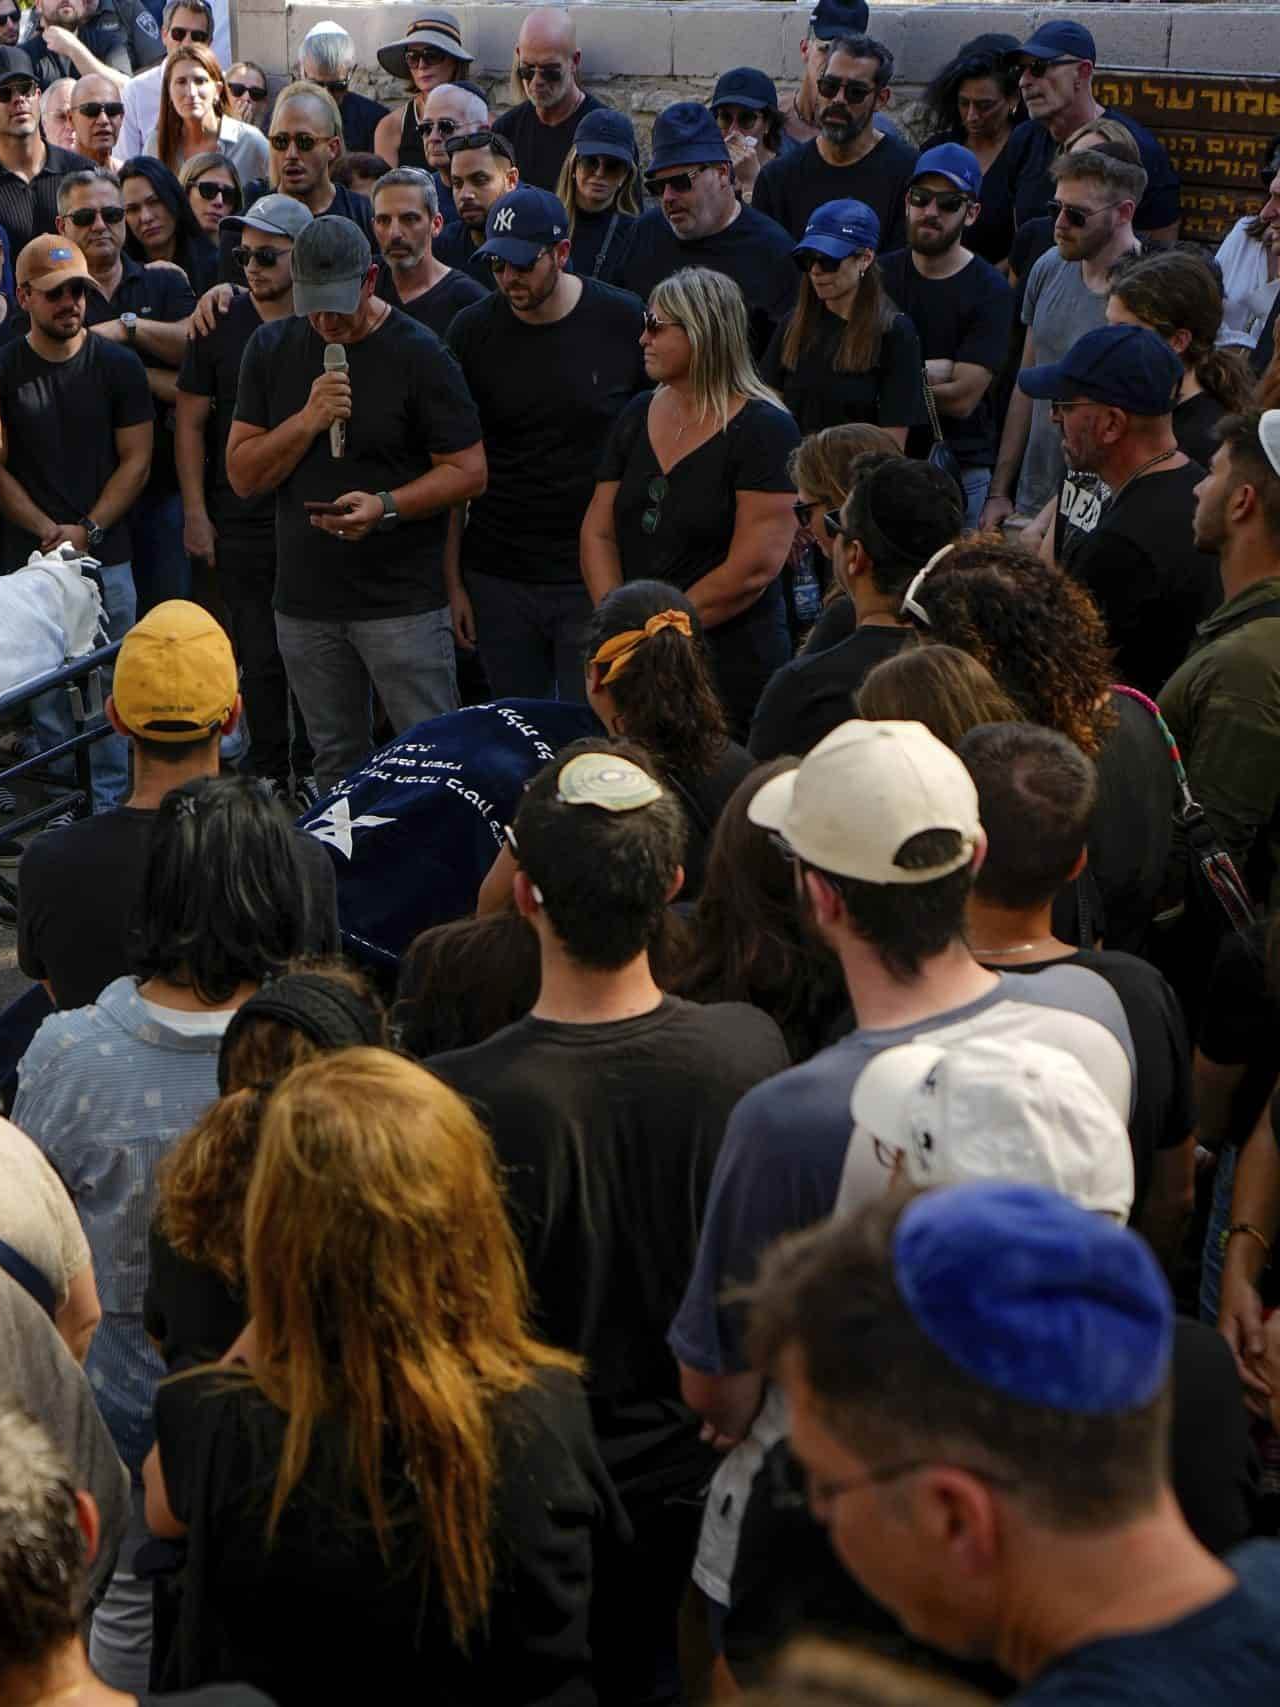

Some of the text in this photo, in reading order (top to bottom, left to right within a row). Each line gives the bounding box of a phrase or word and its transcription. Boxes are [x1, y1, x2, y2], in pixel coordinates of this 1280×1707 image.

[1141, 80, 1195, 112] על
[493, 207, 516, 232] NY
[444, 776, 495, 819] ביטון
